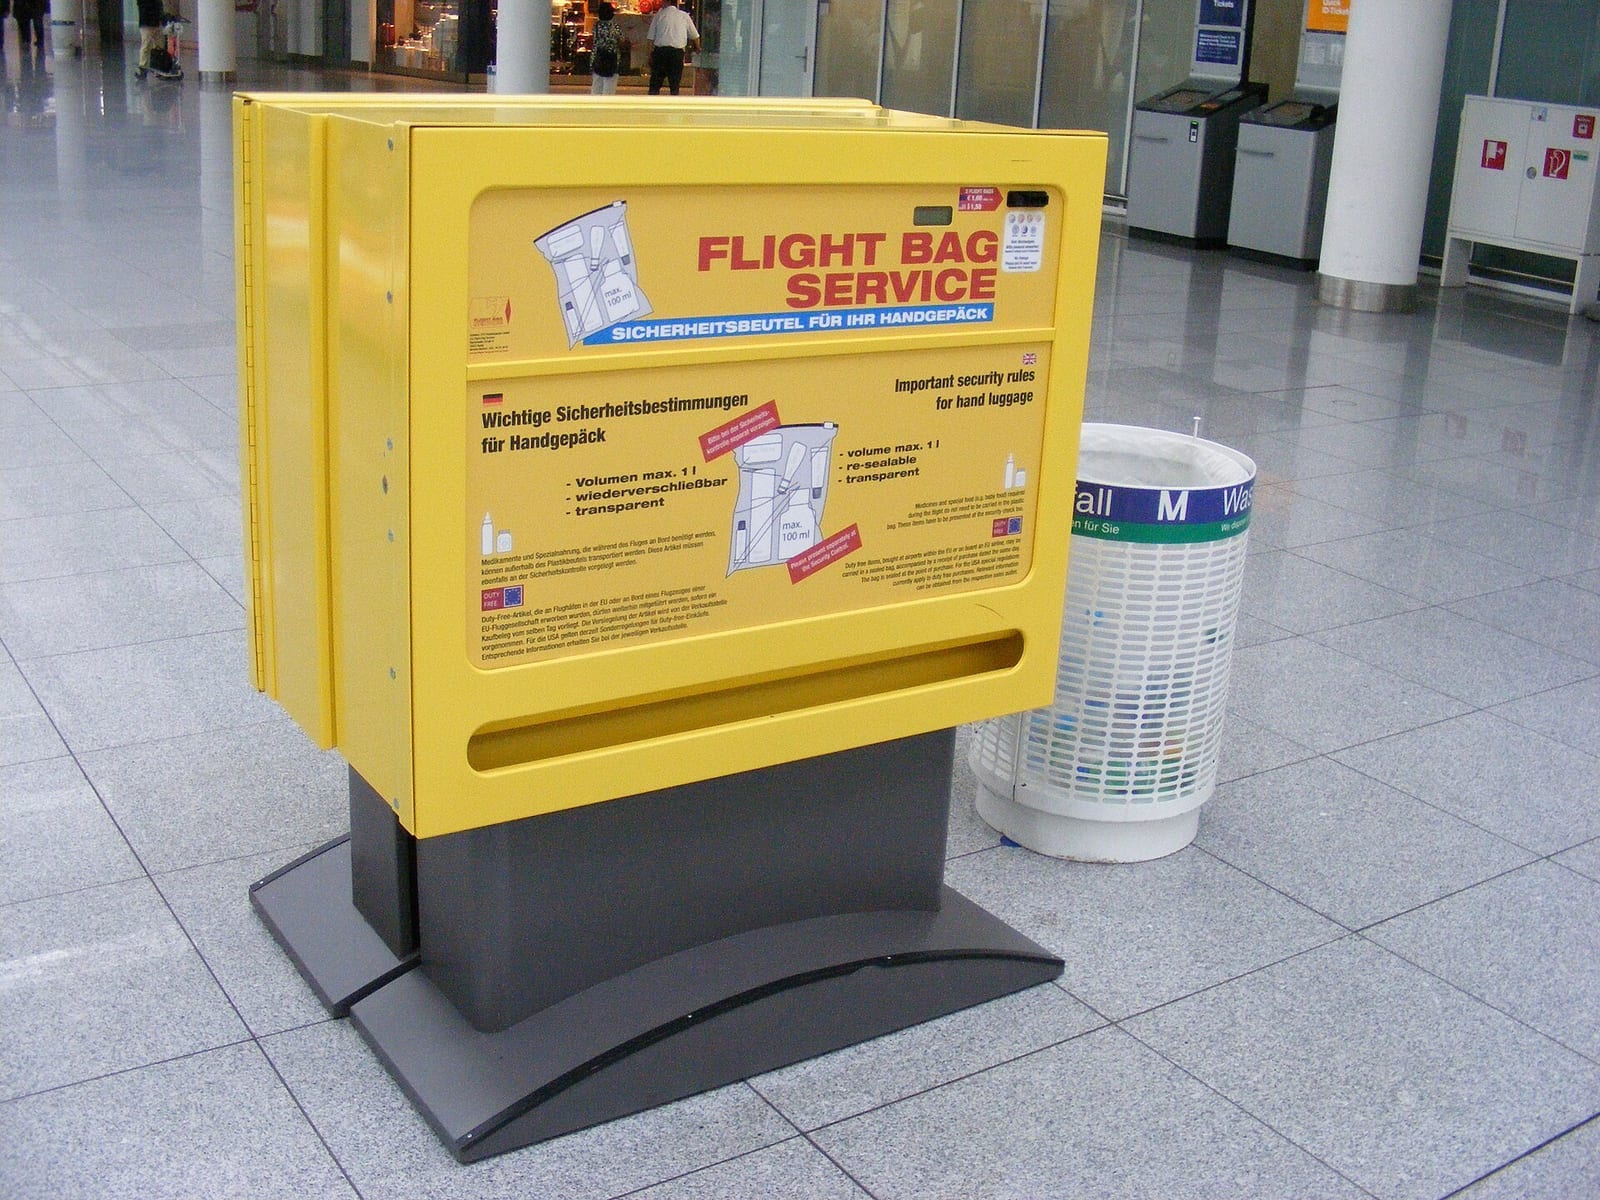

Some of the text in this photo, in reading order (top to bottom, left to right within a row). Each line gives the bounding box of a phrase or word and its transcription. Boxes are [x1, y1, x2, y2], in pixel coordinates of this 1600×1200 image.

[698, 230, 999, 272] FLIGHT BAG
[604, 288, 622, 298] max.
[785, 268, 998, 309] SERVICE
[608, 291, 632, 308] 100 ml
[611, 306, 989, 341] SICHERHEITSBEUTEL FÜR IHR HANDGEPÄCK
[895, 369, 1036, 394] Important security rules
[936, 391, 1034, 410] for hand luggage
[481, 394, 749, 429] Wichtige Sicherheitsbestimmungen
[481, 428, 606, 454] für Handgepäck
[848, 446, 892, 458] volume
[895, 443, 923, 452] max.
[927, 441, 932, 449] 1
[846, 455, 917, 471] re-sealable
[575, 473, 639, 488] Volumen
[642, 469, 677, 481] max.
[681, 466, 688, 477] 1
[846, 467, 920, 484] transparent
[576, 477, 728, 502] wiederverschließbar
[576, 497, 665, 516] transparent
[1075, 485, 1112, 516] all
[1157, 490, 1190, 521] M
[782, 522, 802, 530] max.
[1084, 520, 1120, 534] für Sie
[782, 530, 810, 542] 100 ml
[481, 554, 520, 565] Medikamente
[483, 590, 500, 599] DUTY
